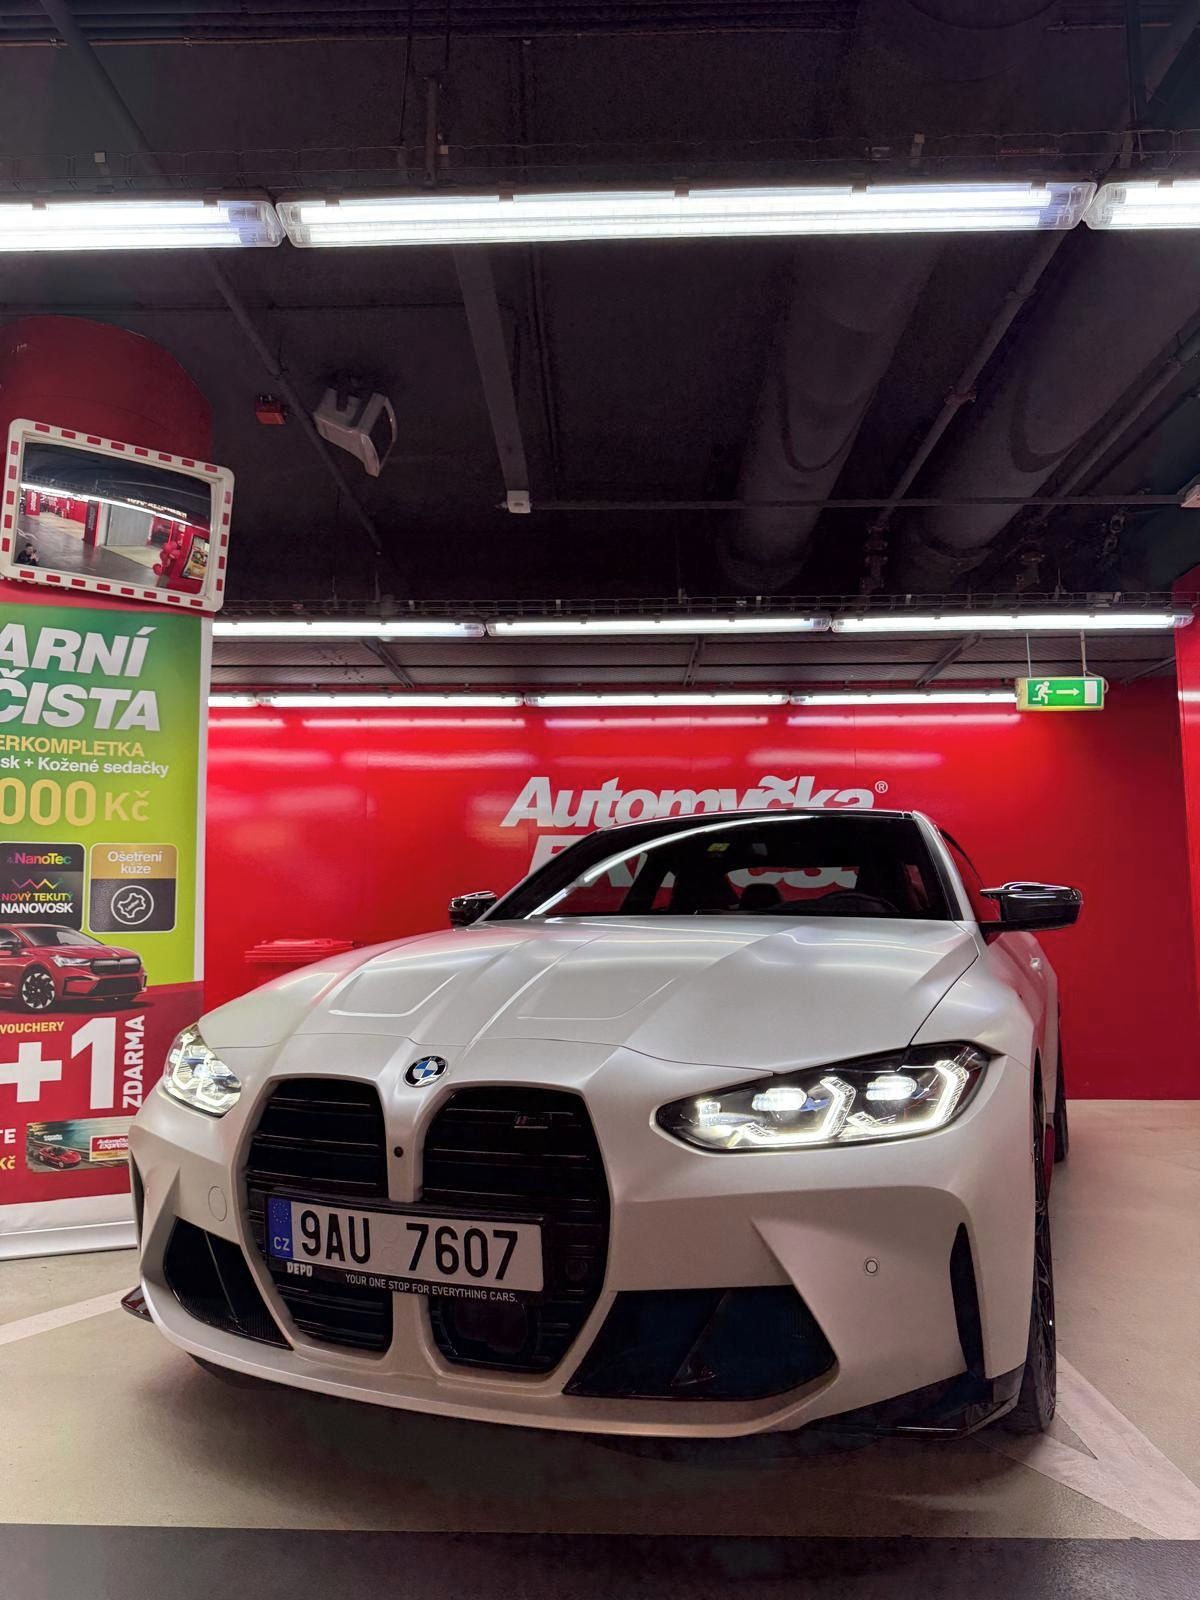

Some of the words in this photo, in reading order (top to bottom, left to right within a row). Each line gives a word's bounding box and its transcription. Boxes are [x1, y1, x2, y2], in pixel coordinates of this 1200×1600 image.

[38, 757, 99, 773] Kožené
[103, 761, 169, 778] sedačky
[104, 790, 151, 821] Kč
[14, 852, 73, 865] NanoTec
[107, 850, 163, 863] Ošetření
[121, 861, 151, 874] kůže
[1, 891, 31, 902] NOVÝ
[1, 902, 74, 914] NANOVOSK
[0, 1021, 64, 1034] VOUCHERY
[122, 1015, 145, 1108] ZDARMA
[273, 1237, 290, 1251] CZ
[300, 1210, 371, 1264] 9AU
[406, 1222, 518, 1281] 7607
[287, 1262, 313, 1277] DEPO
[345, 1274, 367, 1286] YOUR
[369, 1278, 387, 1289] ONE
[388, 1281, 410, 1291] STOP
[412, 1284, 429, 1294] FOR
[432, 1286, 487, 1300] EVERYTHING
[490, 1291, 518, 1303] CARS.
